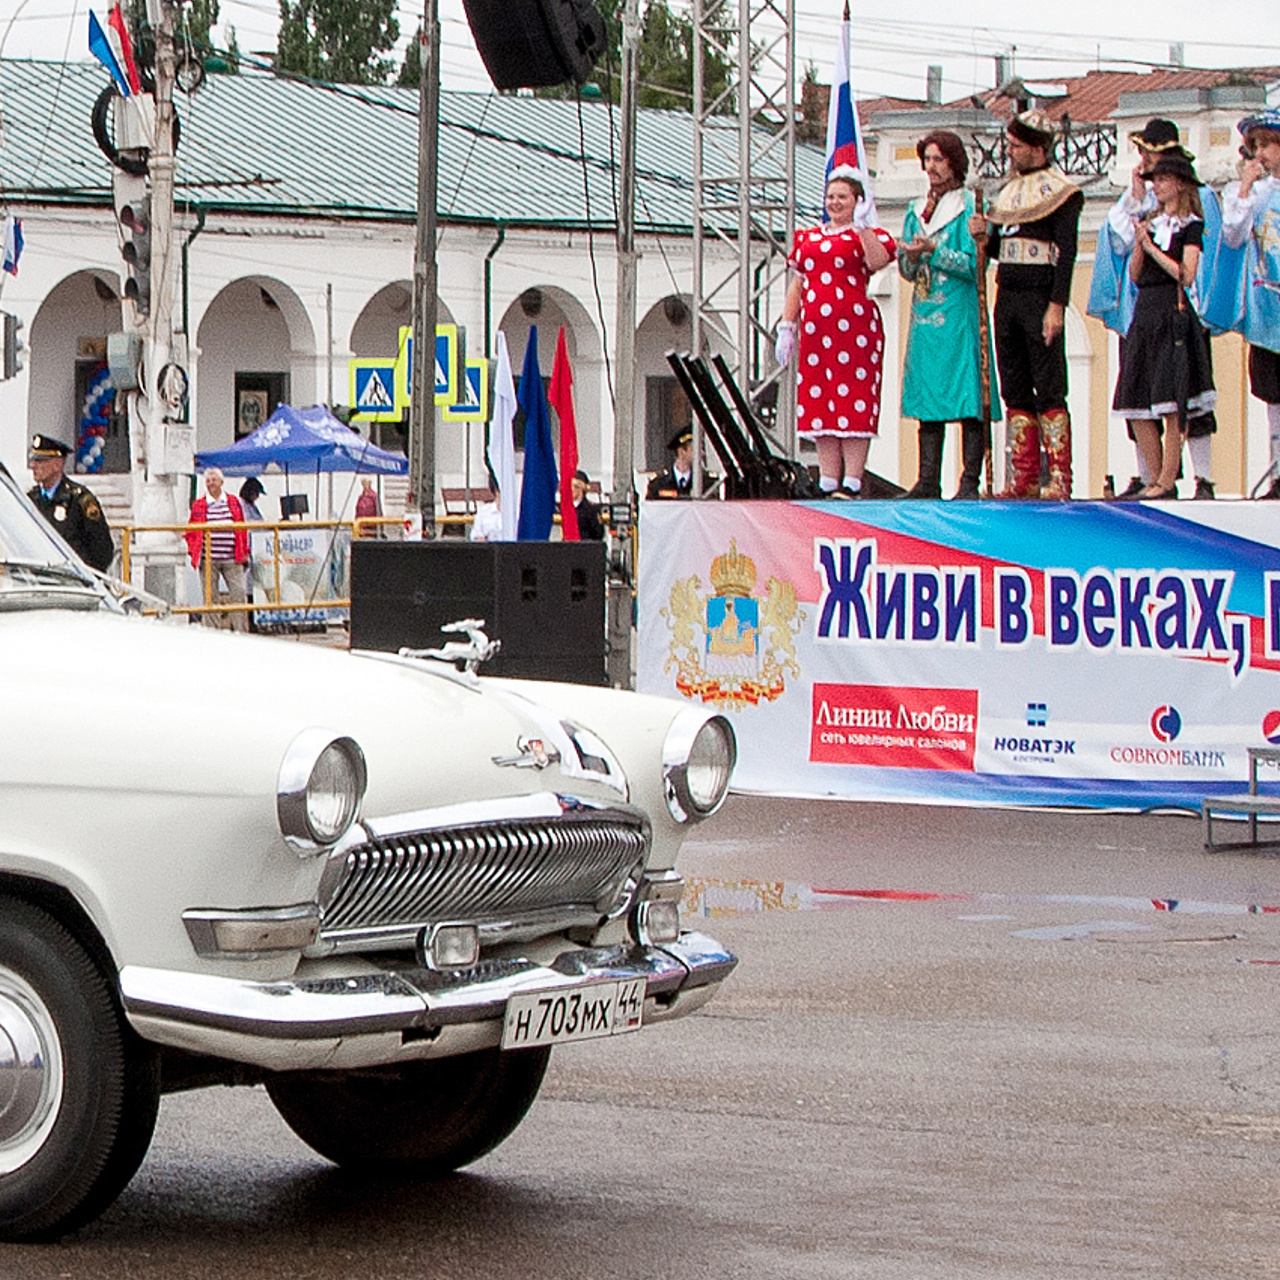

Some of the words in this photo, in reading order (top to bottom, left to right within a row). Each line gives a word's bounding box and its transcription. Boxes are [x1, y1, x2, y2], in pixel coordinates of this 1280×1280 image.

[818, 544, 977, 642] Живи
[999, 574, 1029, 644] в
[1051, 576, 1246, 677] веках,
[815, 700, 892, 729] Линии
[897, 704, 975, 733] Любви
[820, 733, 846, 745] сеть
[848, 734, 915, 749] ювелирных
[918, 737, 966, 751] салонов
[993, 737, 1076, 754] НОВАТЭК
[1110, 746, 1225, 767] СОВКОМБАНК
